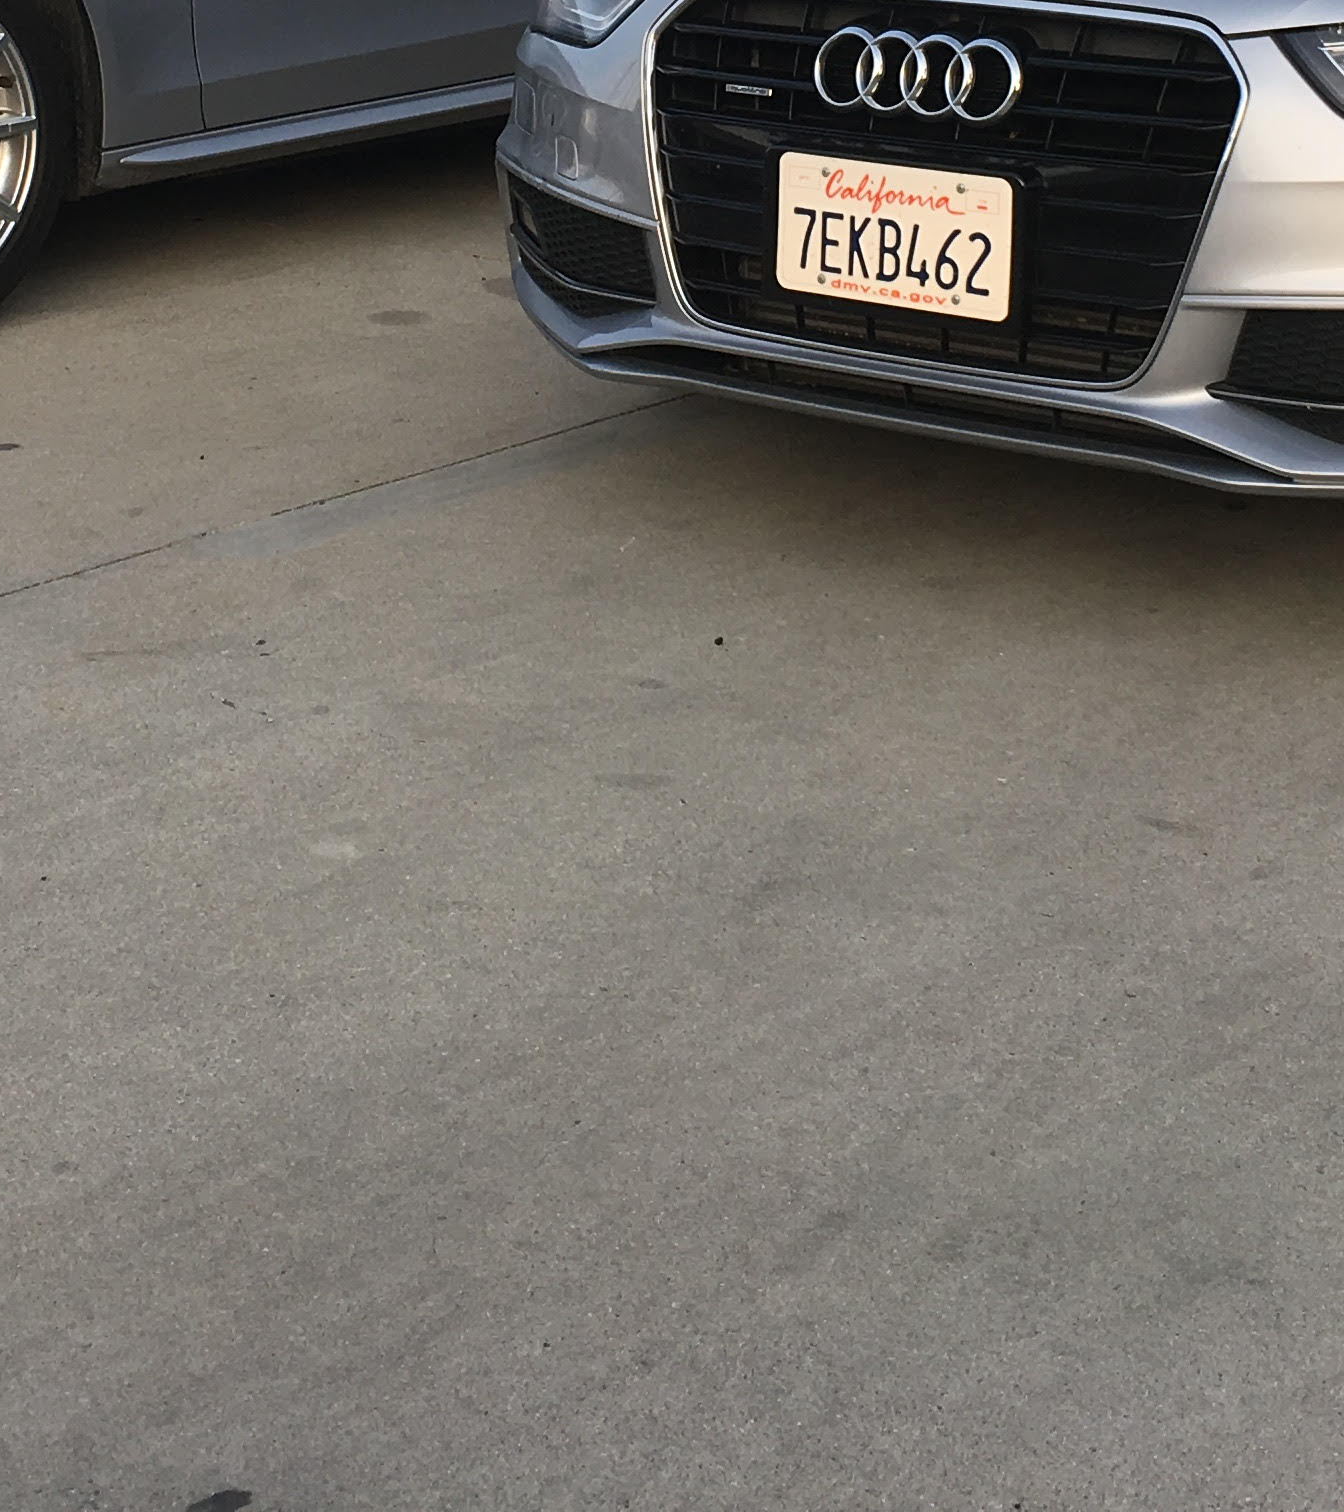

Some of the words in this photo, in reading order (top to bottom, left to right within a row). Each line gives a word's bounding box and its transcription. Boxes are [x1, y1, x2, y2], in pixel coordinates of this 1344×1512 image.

[824, 169, 966, 215] California
[793, 206, 993, 297] 7EKB462
[830, 277, 947, 306] dmv.ca.gov
